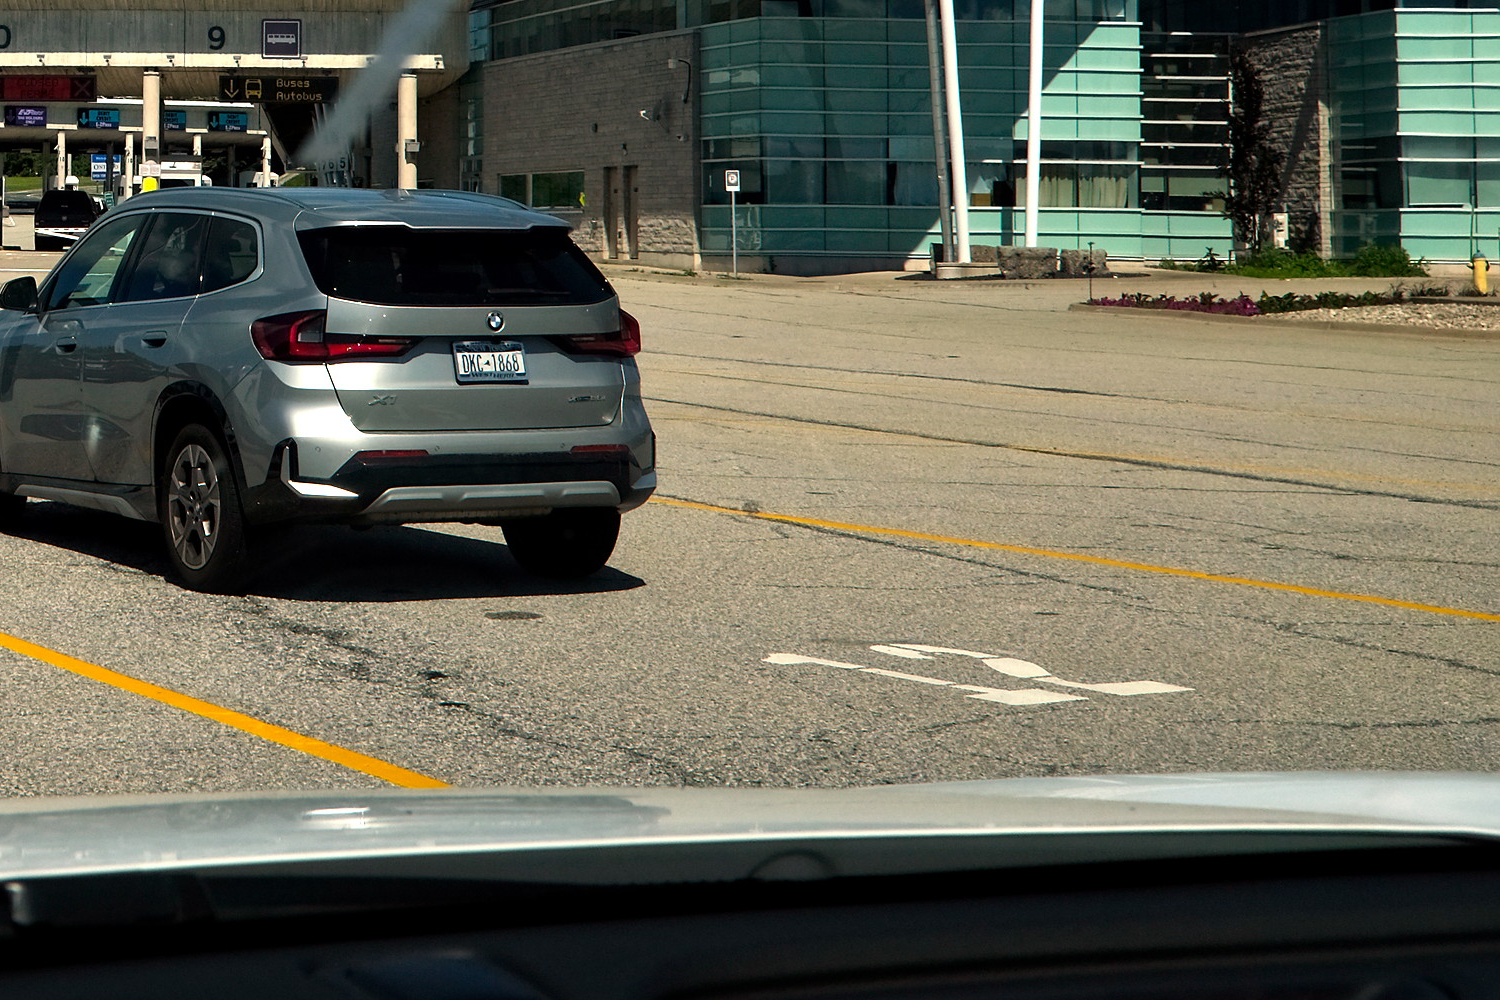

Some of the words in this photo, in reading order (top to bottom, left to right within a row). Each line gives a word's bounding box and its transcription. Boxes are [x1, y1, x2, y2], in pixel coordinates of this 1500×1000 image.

[207, 26, 226, 50] 9
[276, 79, 310, 87] Buses
[276, 92, 322, 100] Autobus
